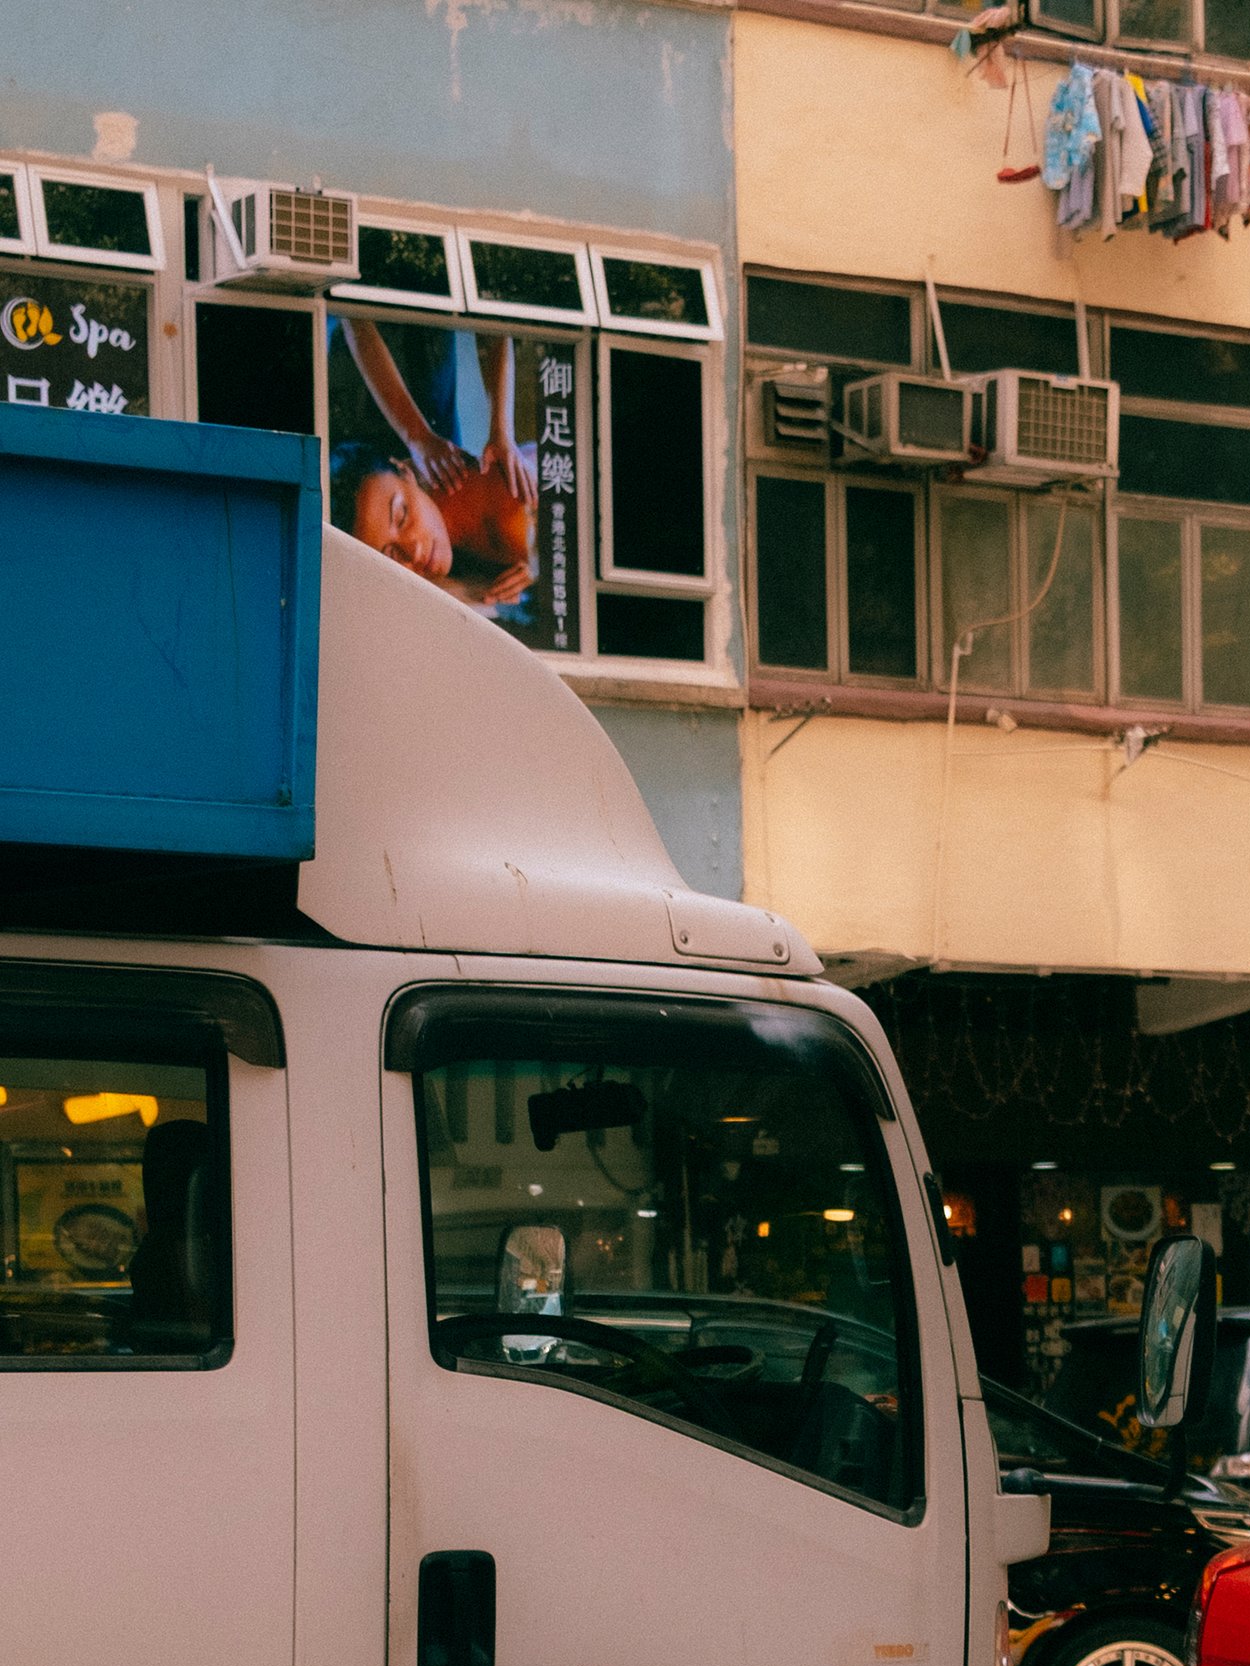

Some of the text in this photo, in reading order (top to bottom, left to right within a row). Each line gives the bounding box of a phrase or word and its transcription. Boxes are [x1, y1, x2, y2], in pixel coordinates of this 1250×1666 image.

[69, 303, 136, 358] Spa
[539, 357, 575, 494] 御足樂
